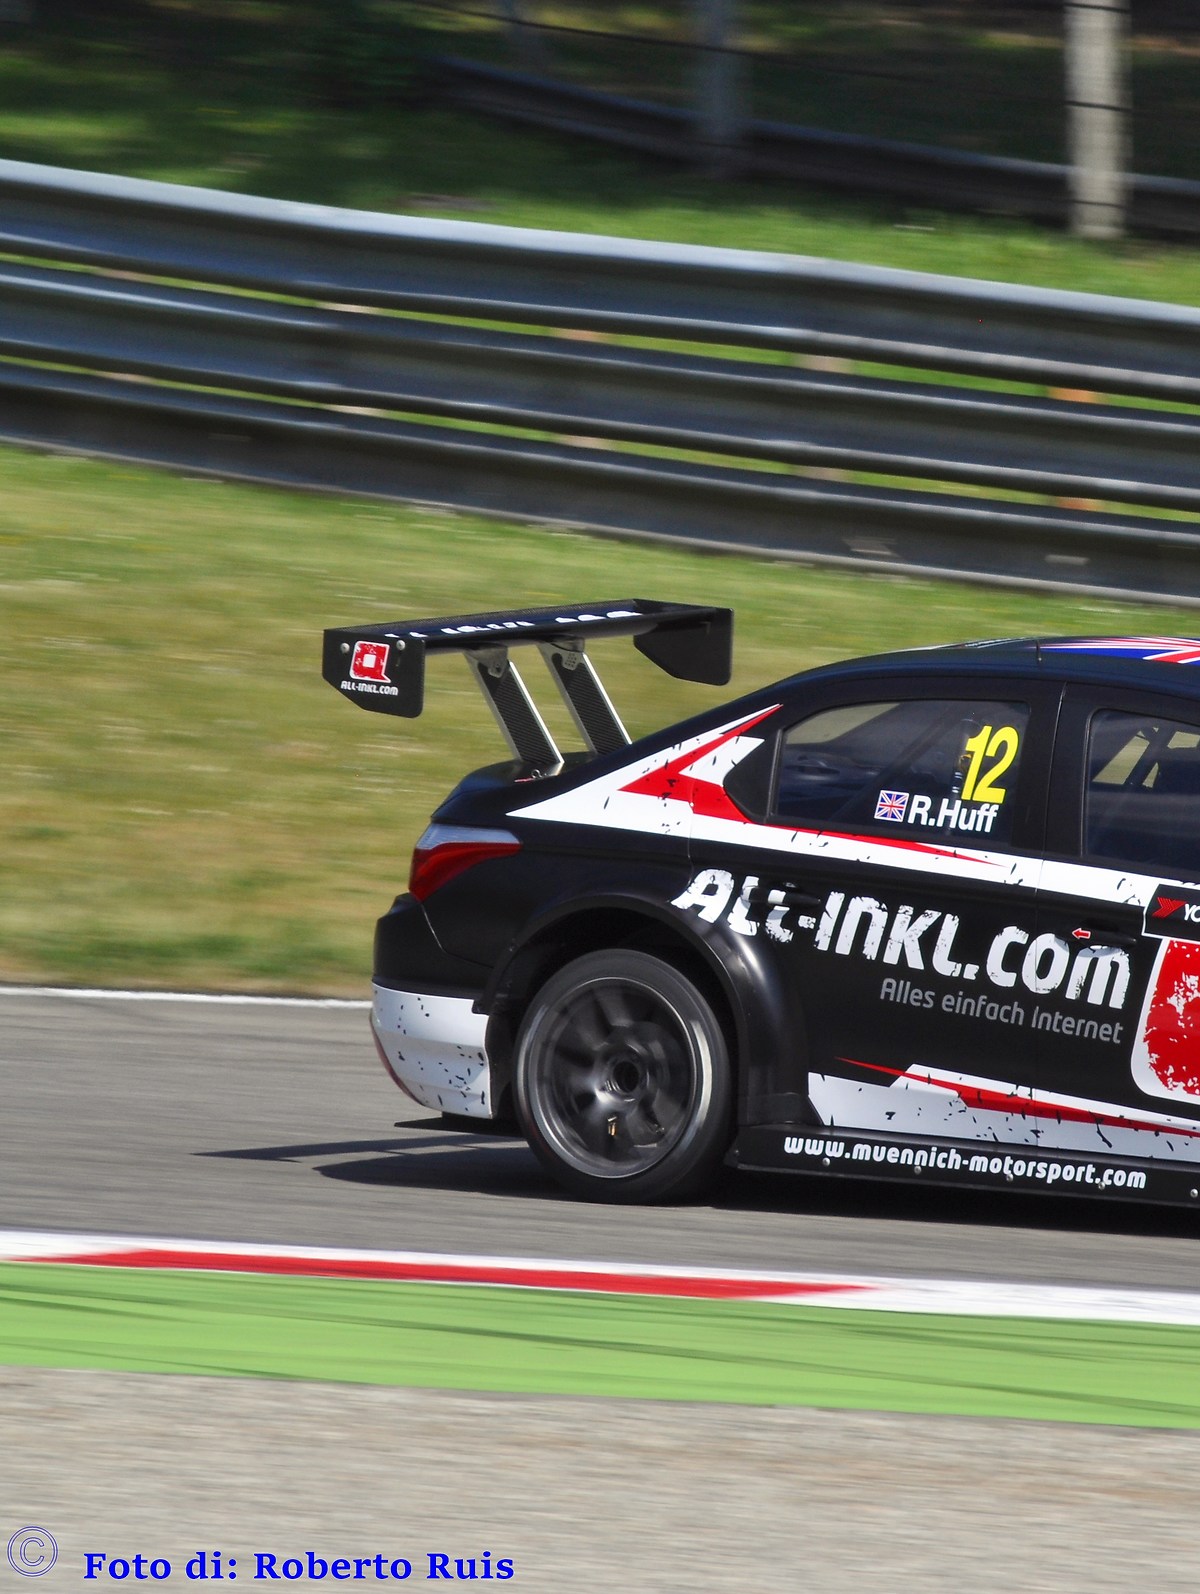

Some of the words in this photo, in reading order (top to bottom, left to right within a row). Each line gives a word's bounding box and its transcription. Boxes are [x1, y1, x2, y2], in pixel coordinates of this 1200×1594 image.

[961, 725, 1019, 804] 12
[907, 794, 1000, 833] R.Huff
[880, 977, 935, 1010] Alles
[941, 992, 1024, 1027] einfach
[1032, 1004, 1124, 1044] Internet
[784, 1136, 1148, 1189] www.muennich-motorsport.com
